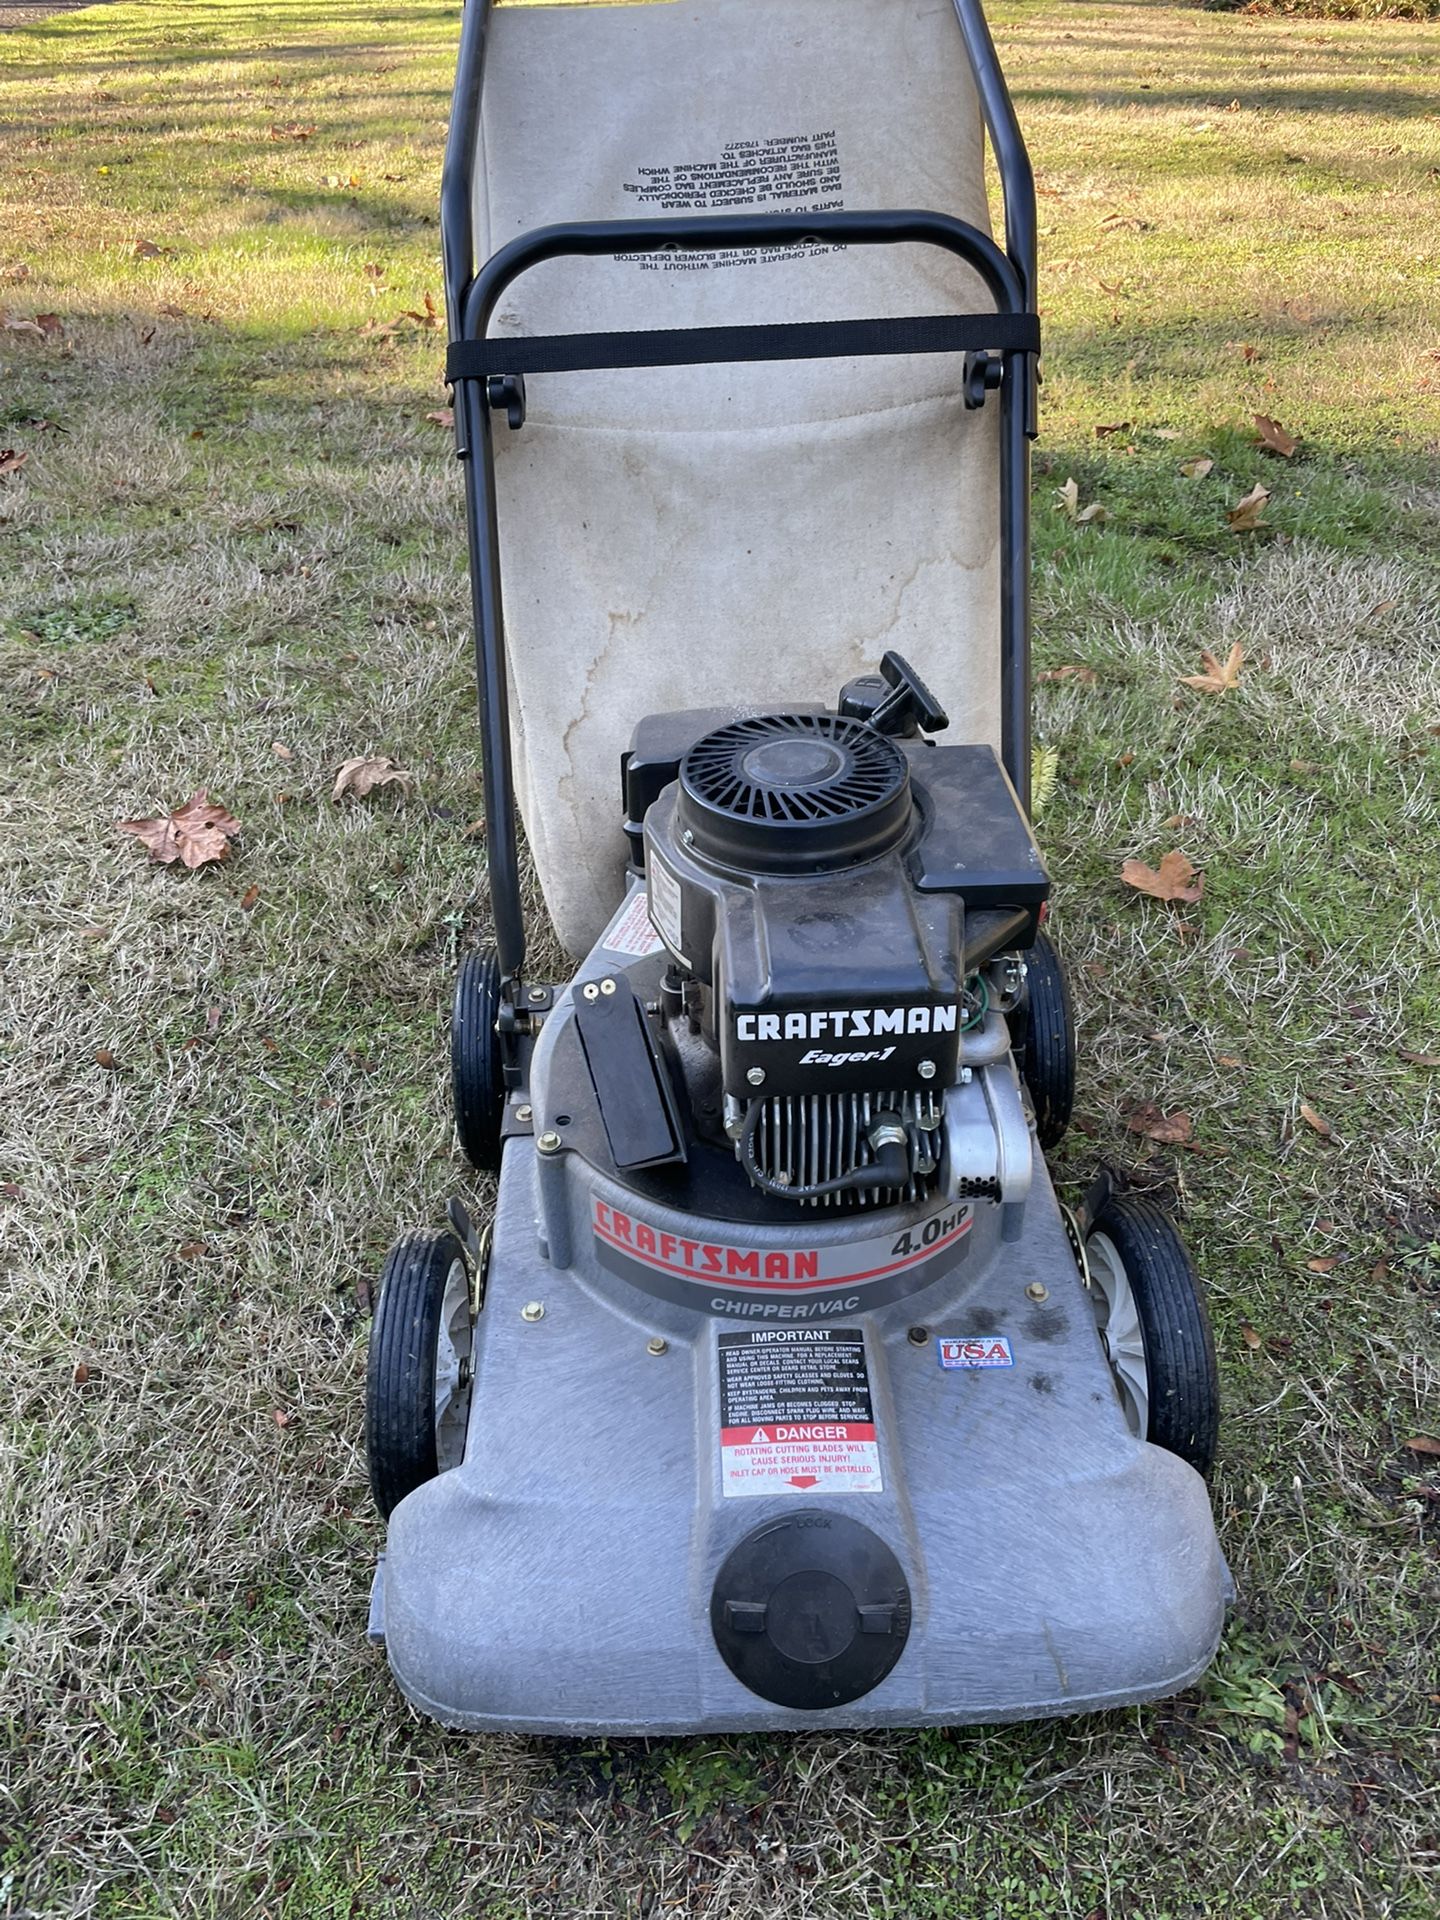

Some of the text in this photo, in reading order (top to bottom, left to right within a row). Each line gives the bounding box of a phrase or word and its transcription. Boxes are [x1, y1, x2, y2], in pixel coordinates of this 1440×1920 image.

[812, 132, 835, 143] PART
[791, 144, 811, 153] BAG
[814, 140, 836, 150] THIS
[739, 147, 787, 158] ATTACHES
[638, 151, 837, 175] MANUFACTURER OF THE MACHINE WHICH
[791, 162, 810, 172] THE
[814, 159, 839, 169] WITH
[690, 165, 787, 181] RECOMMENDATIONS
[623, 167, 840, 193] BE SURE ANY REPLACEMENT BAG COMPLIES
[651, 176, 670, 184] THE
[775, 179, 816, 190] SHOULD
[820, 176, 840, 186] AND
[709, 186, 756, 198] CHECKED
[759, 184, 772, 192] BE
[662, 184, 842, 209] BAG MATERIAL IS SUBJECT TO WEAR
[812, 201, 843, 211] PARTS
[674, 253, 716, 261] BLOWER
[720, 250, 738, 259] THE
[743, 248, 757, 257] OR
[761, 251, 805, 264] OPERATE
[809, 247, 828, 257] NOT
[614, 254, 671, 262] DEFLECTOR
[713, 258, 756, 269] MACHINE
[664, 262, 709, 270] WITHOUT
[737, 1005, 957, 1040] CRAFTSMAN
[595, 1201, 818, 1278] CRAFTSMAN
[710, 1296, 860, 1318] CHIPPER/VAC
[752, 1331, 831, 1342] IMPORTANT
[942, 1344, 1009, 1359] USA
[776, 1427, 847, 1440] DANGER
[735, 1448, 771, 1456] ROTATING
[777, 1446, 809, 1454] CUTTING
[812, 1445, 843, 1453] BLADES
[752, 1455, 850, 1465] CAUSE SERIOUS INJURY!
[801, 1467, 821, 1475] MUST
[823, 1466, 832, 1474] BE
[834, 1466, 874, 1474] INSTALLED.
